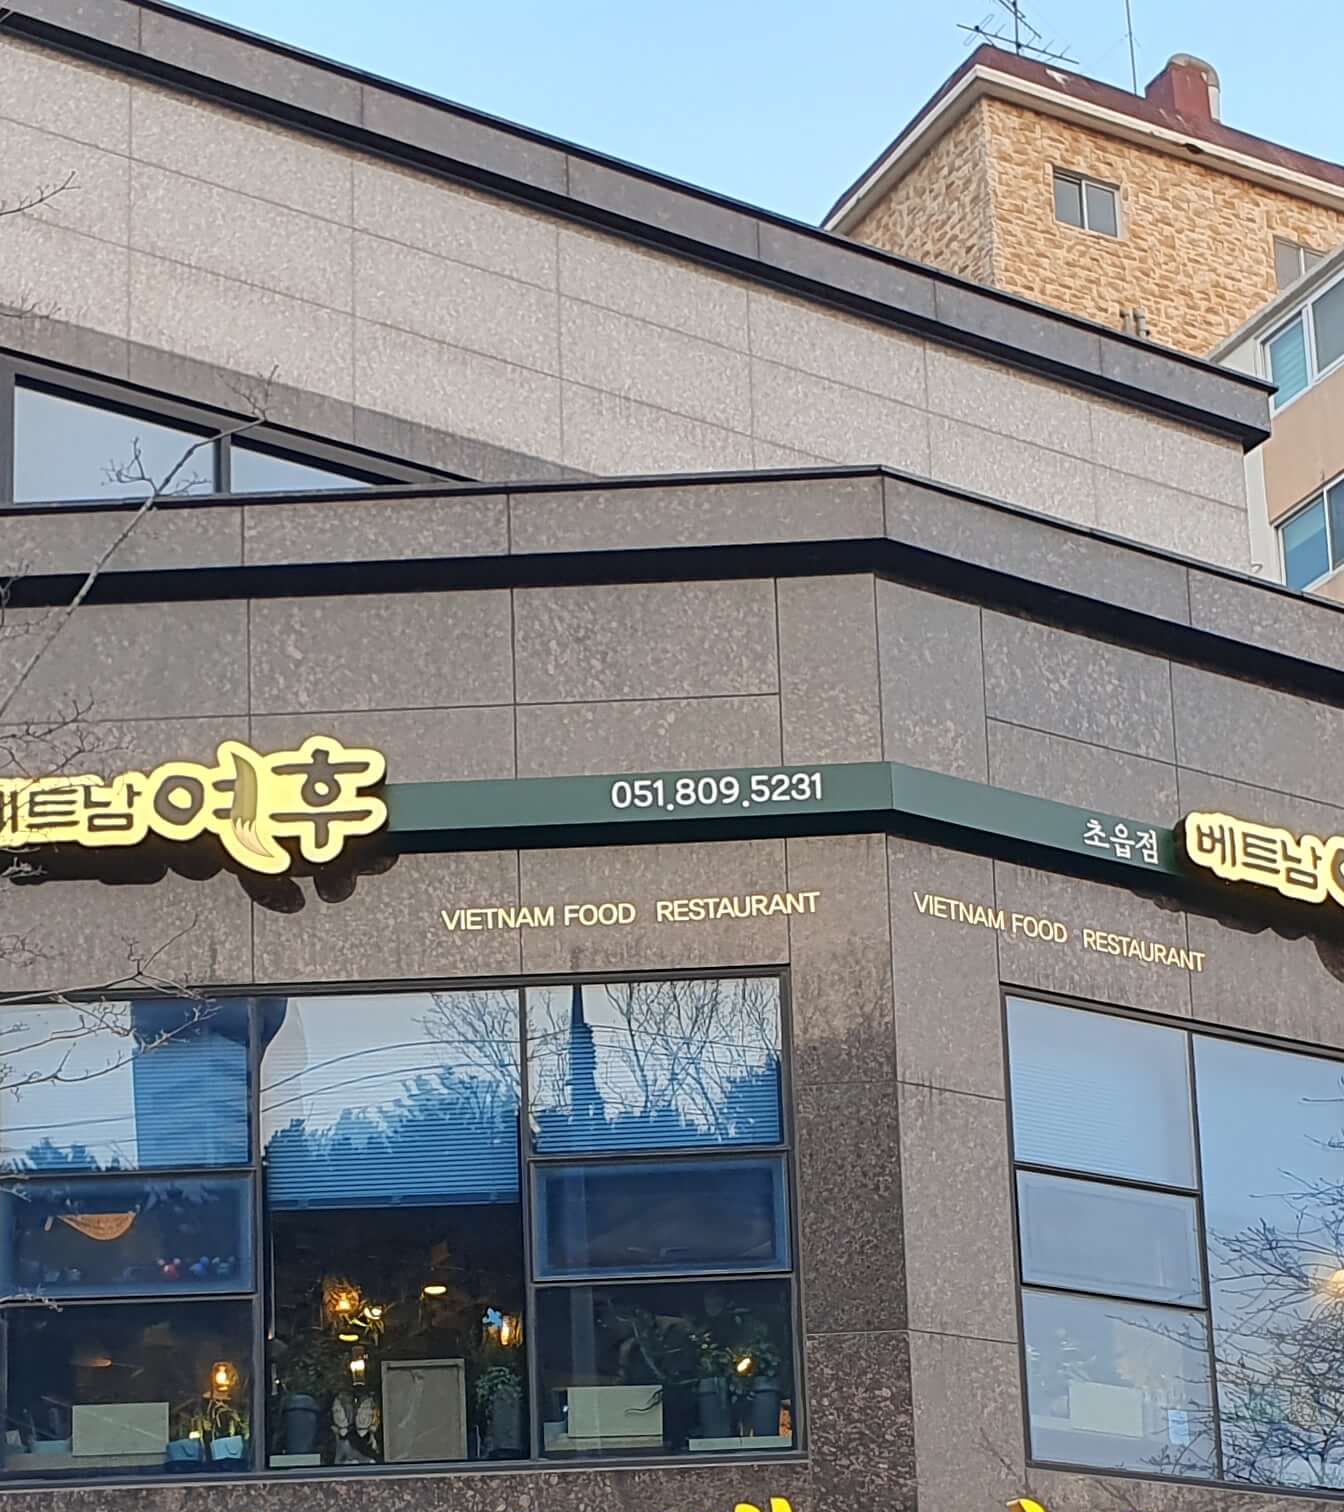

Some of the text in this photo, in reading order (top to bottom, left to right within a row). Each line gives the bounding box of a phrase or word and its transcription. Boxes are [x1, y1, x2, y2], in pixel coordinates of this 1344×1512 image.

[611, 772, 823, 811] 051.809.5231
[1082, 817, 1160, 866] 초읍점
[441, 891, 820, 931] VIETNAM FOOD RESTAURANT
[912, 890, 1206, 973] VIETNAM FOOD RESTAURANT
